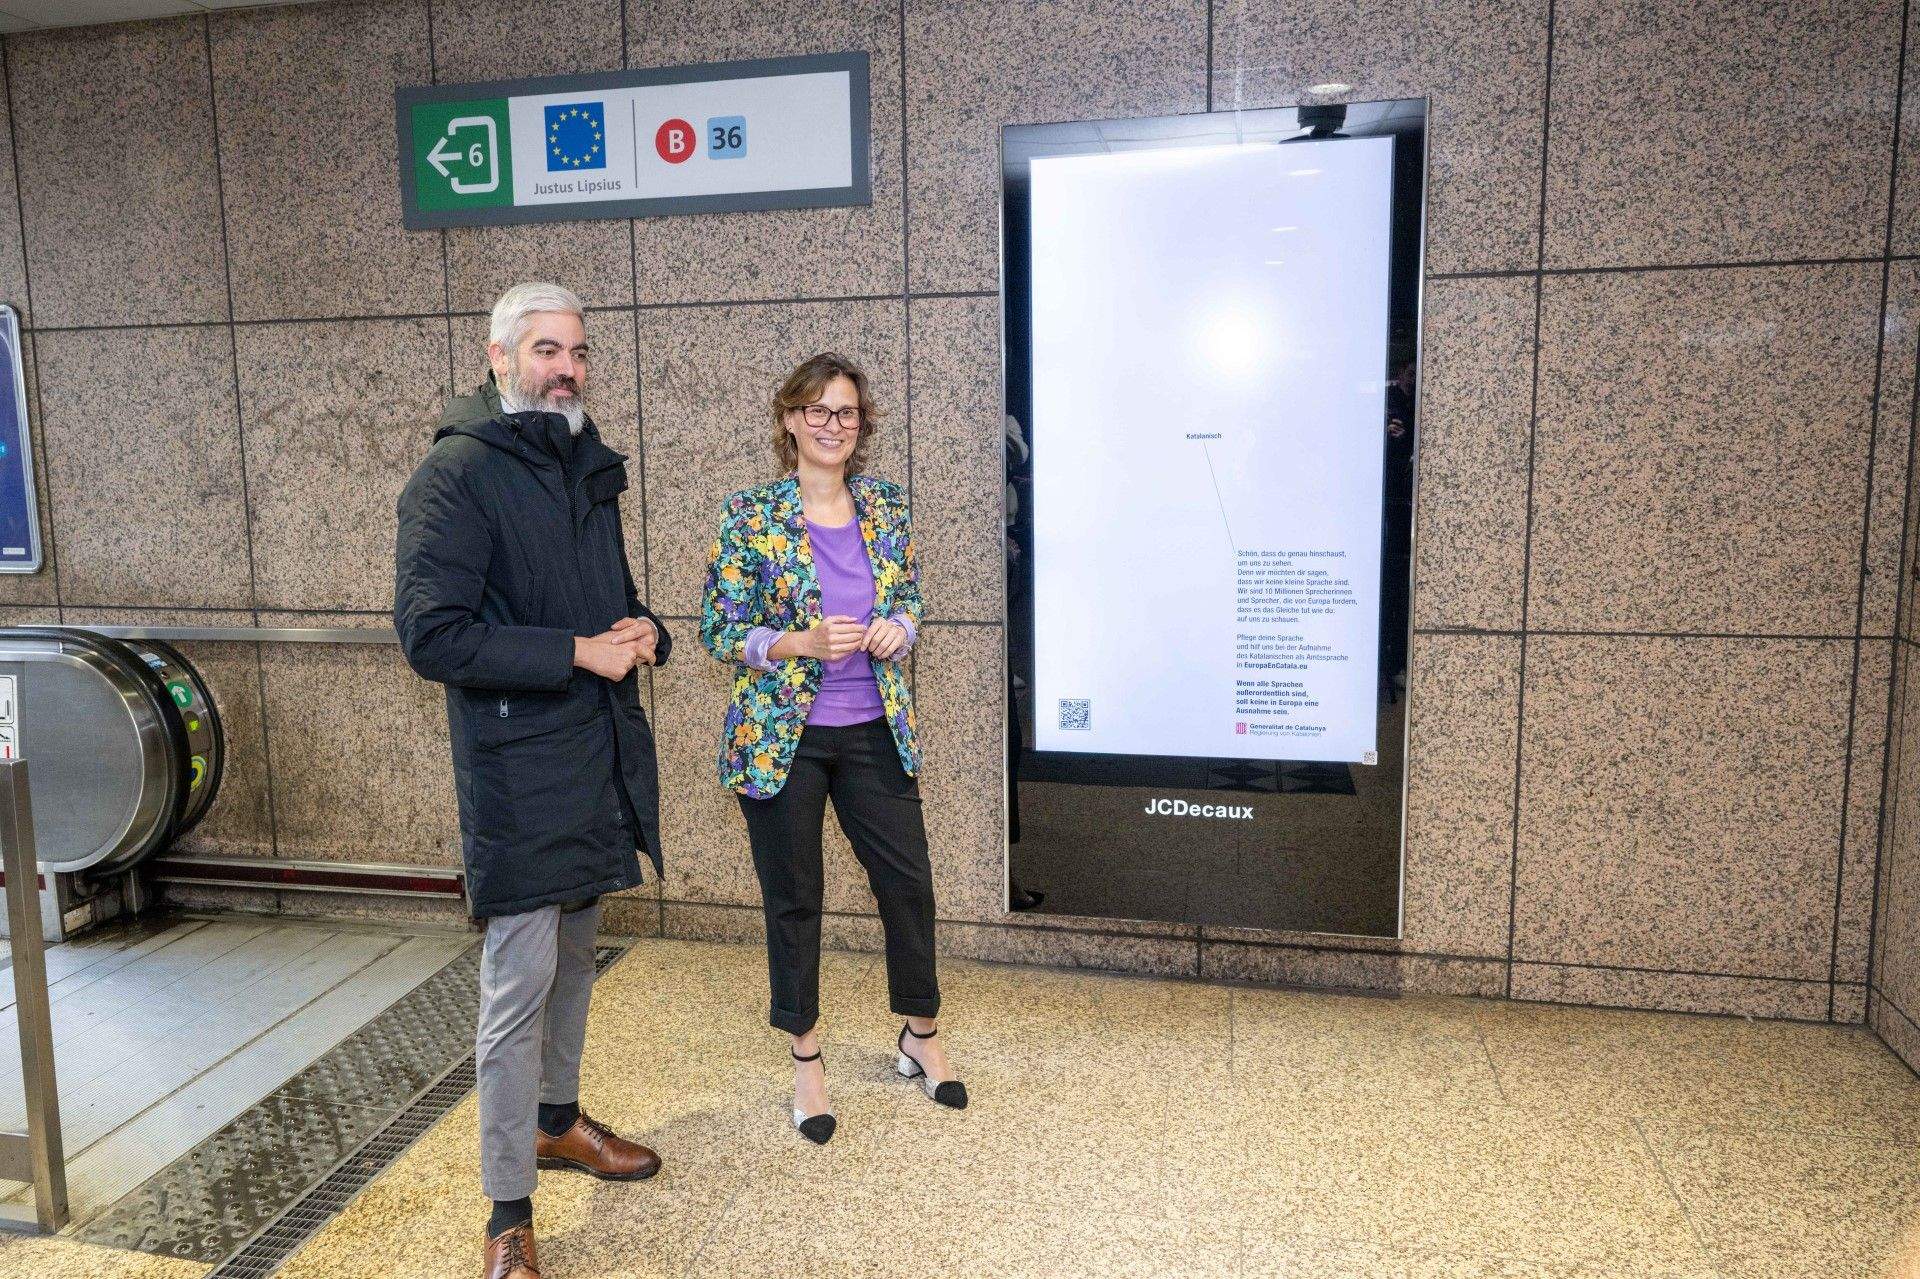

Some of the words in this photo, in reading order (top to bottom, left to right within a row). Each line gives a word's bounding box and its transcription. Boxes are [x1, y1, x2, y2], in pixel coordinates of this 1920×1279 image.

[669, 129, 685, 153] B
[712, 126, 742, 150] 36
[469, 143, 484, 167] 6
[534, 182, 573, 195] Justus
[577, 179, 621, 194] Lipsius
[1288, 551, 1308, 560] genau
[1309, 550, 1347, 558] hinschaust,
[1306, 578, 1333, 587] Sprache
[1305, 588, 1353, 596] Sprecherinnen
[1308, 598, 1331, 606] Europa
[1276, 606, 1300, 614] Gleiche
[1236, 634, 1257, 642] Pflege
[1277, 634, 1304, 643] Sprache
[1299, 644, 1332, 652] Aufnahme
[1306, 654, 1349, 662] Amtssprache
[1271, 681, 1304, 689] Sprachen
[1278, 699, 1303, 708] Europa
[1236, 707, 1272, 715] Ausnahme
[1285, 723, 1294, 731] de
[1295, 724, 1327, 732] Catalunya
[1144, 798, 1254, 820] JCDecaux
